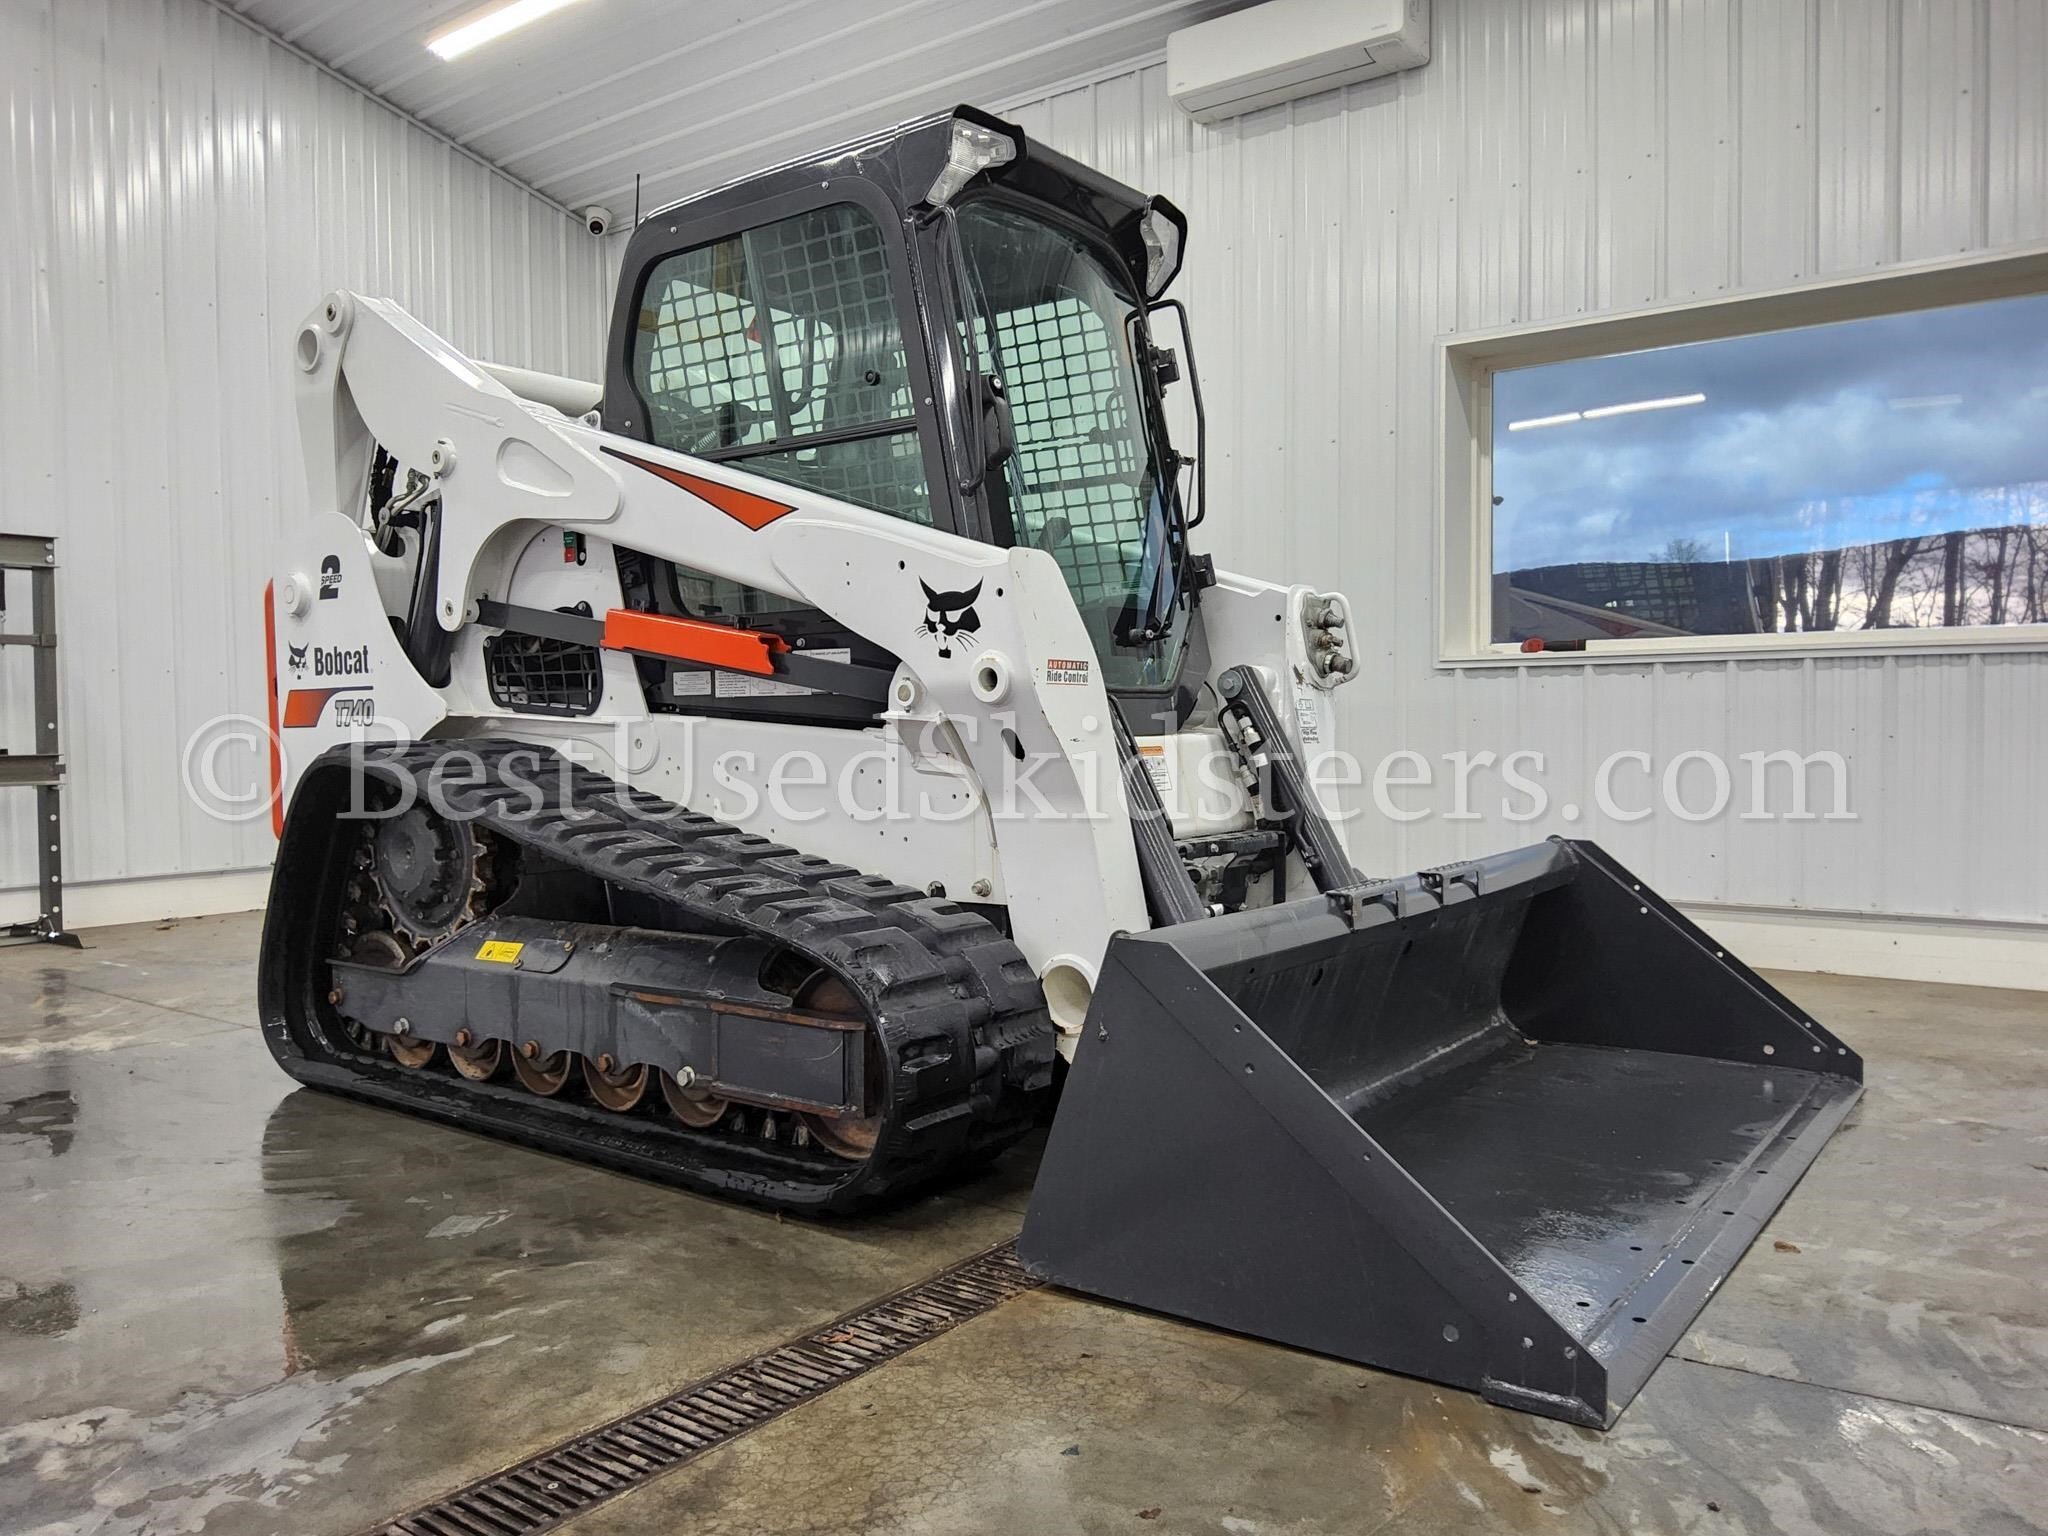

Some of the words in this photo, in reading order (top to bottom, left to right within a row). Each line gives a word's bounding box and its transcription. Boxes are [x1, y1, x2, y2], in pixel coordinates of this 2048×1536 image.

[321, 574, 343, 586] SPEED
[314, 645, 369, 676] Bobcat
[1048, 660, 1088, 670] AUTOMATIC
[1047, 670, 1062, 682] Ride
[1063, 671, 1088, 683] Control
[335, 698, 374, 727] T740
